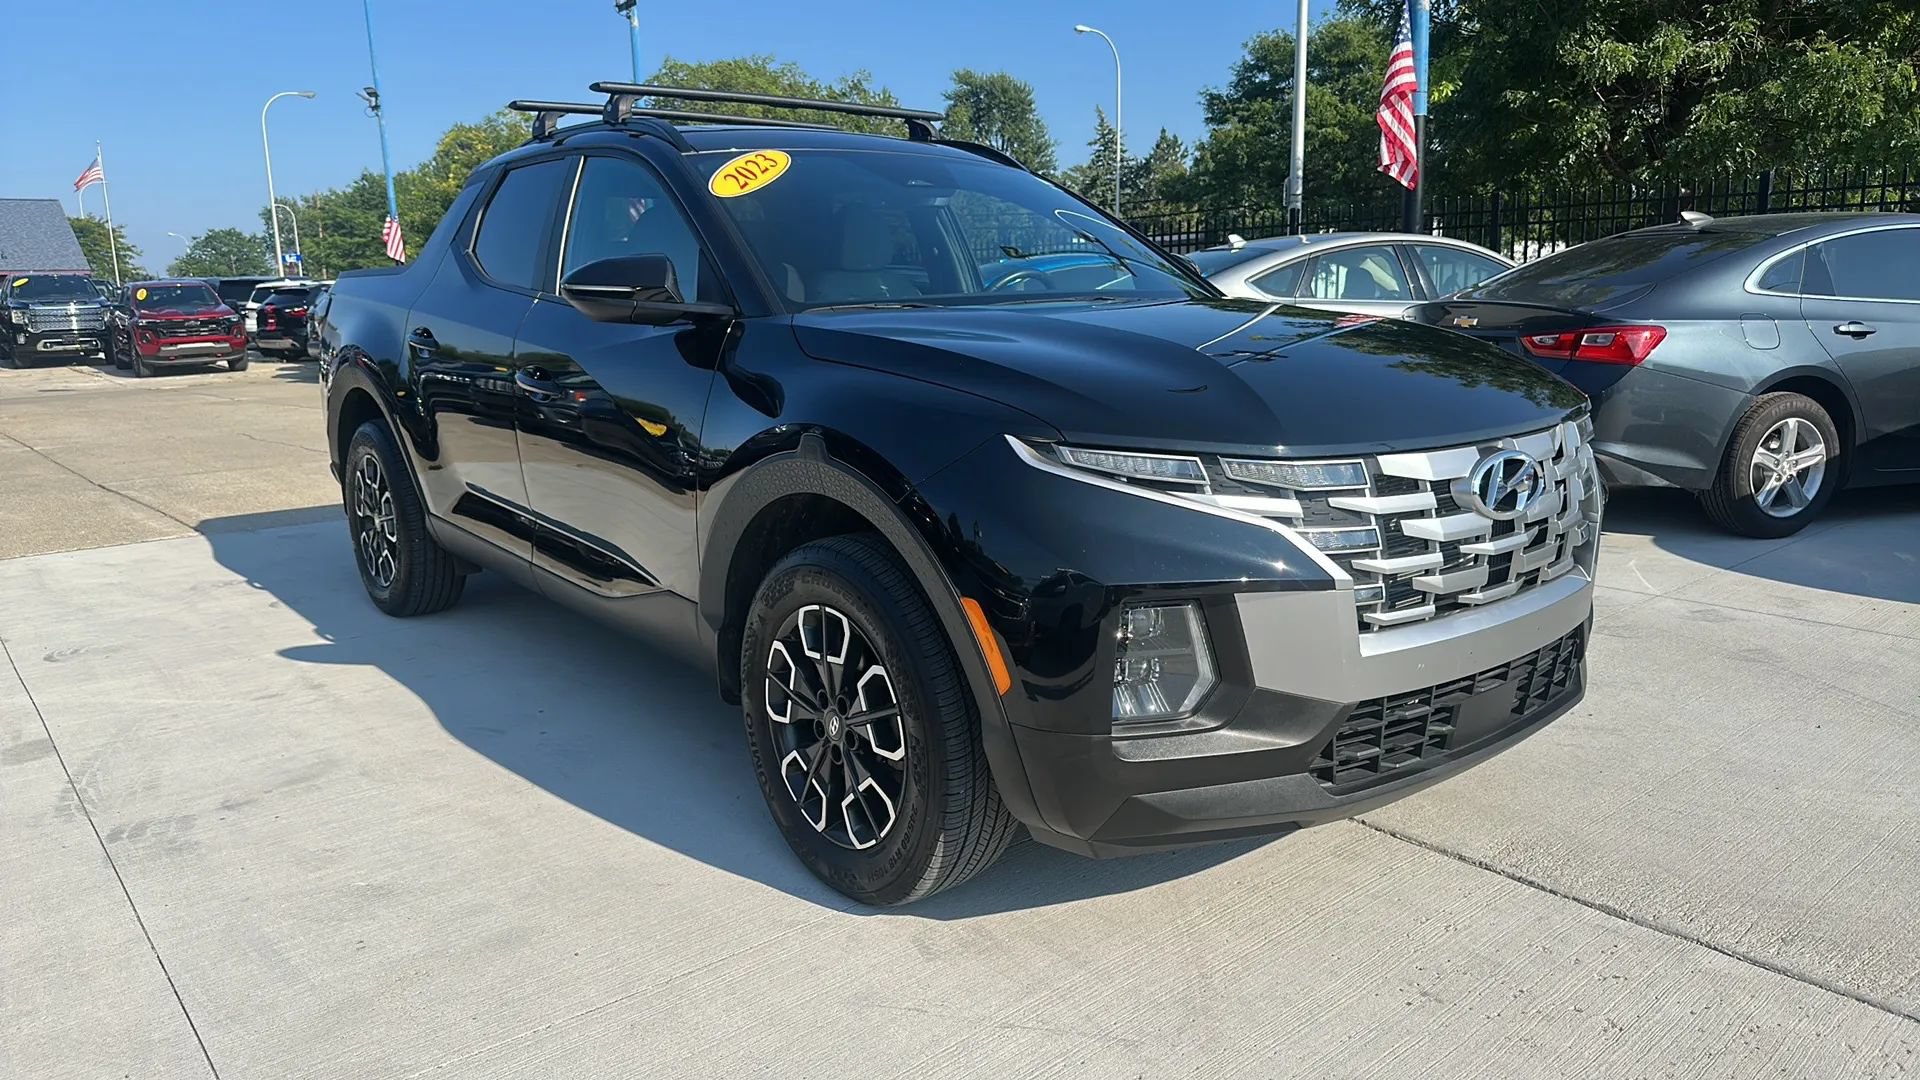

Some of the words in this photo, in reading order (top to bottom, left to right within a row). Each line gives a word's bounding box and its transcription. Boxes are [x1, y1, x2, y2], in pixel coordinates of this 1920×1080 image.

[724, 154, 778, 190] 2023
[901, 802, 919, 850] 245/60
[888, 847, 903, 869] R18
